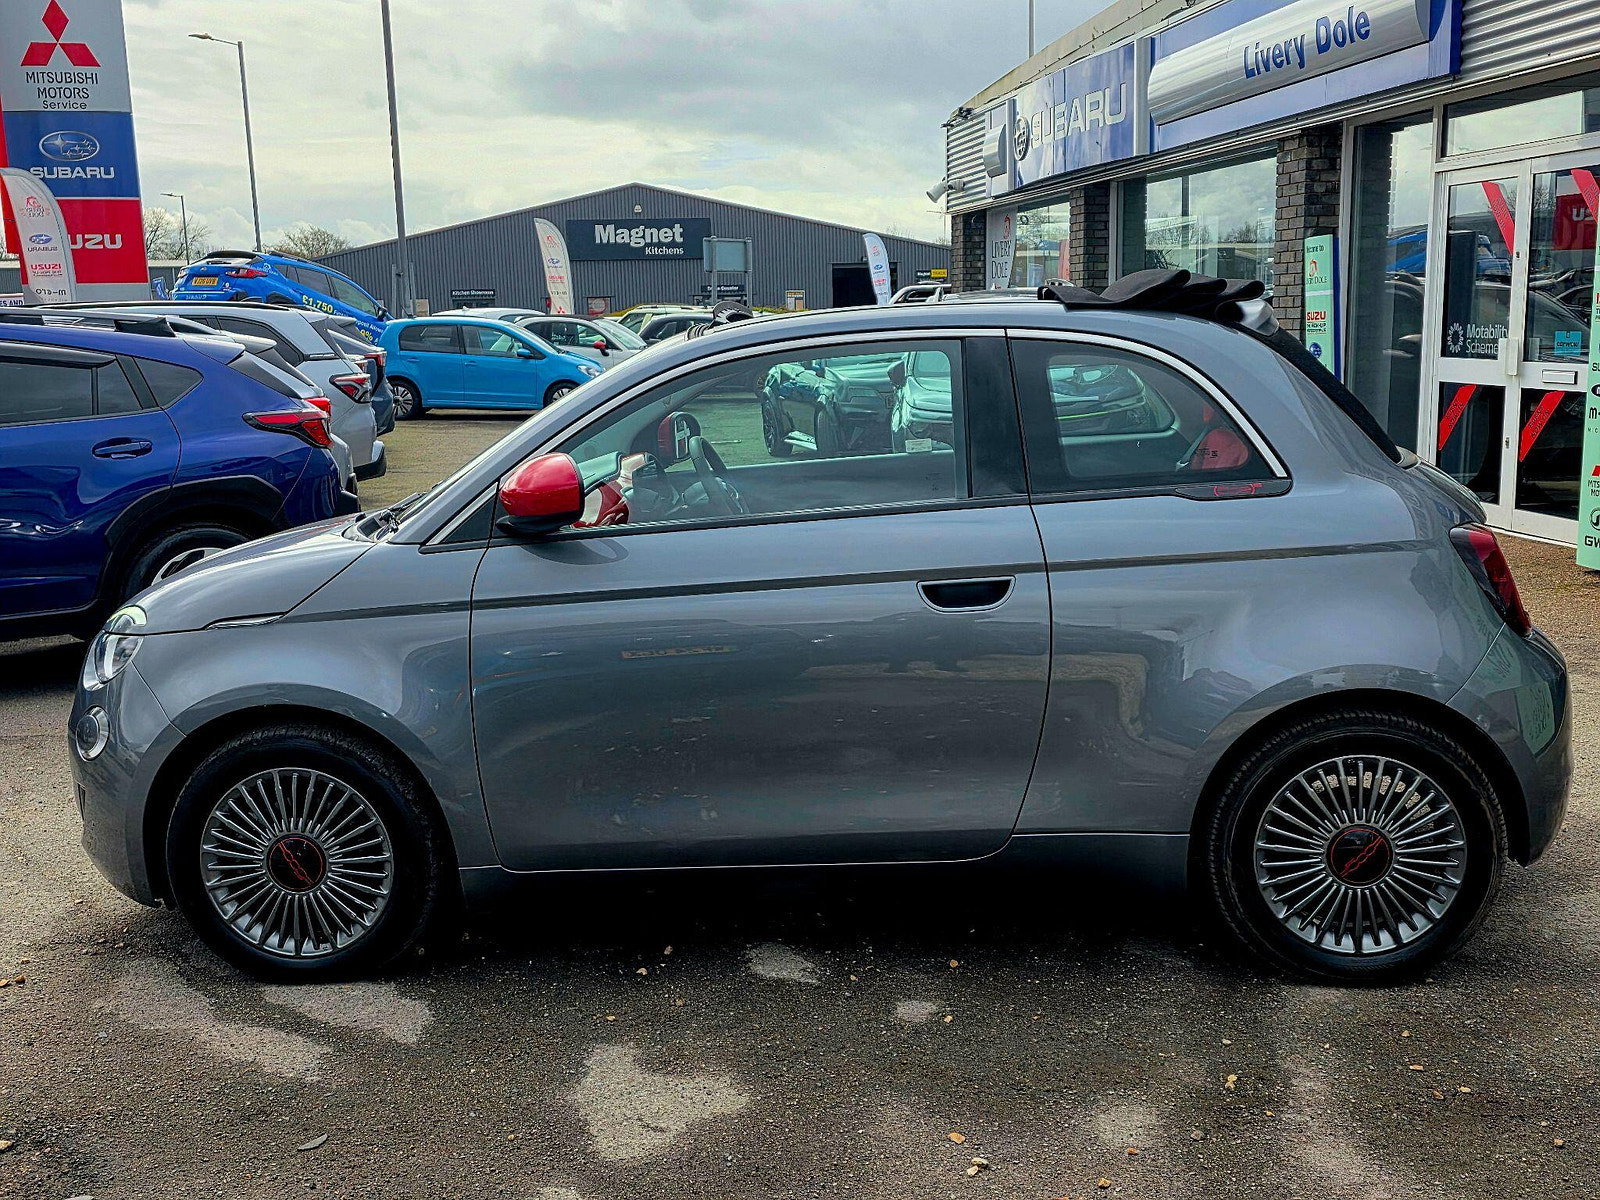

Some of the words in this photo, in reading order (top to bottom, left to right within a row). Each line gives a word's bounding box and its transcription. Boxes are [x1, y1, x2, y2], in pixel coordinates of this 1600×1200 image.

[1243, 34, 1306, 79] Livery
[1316, 5, 1371, 55] Dole
[26, 71, 99, 85] MITSUBISHI
[37, 86, 90, 100] MOTORS
[42, 99, 88, 110] Service
[1031, 82, 1127, 149] SUBARU
[30, 166, 116, 179] SUBARU
[594, 223, 684, 247] Magnet
[645, 245, 684, 255] Kitchens
[991, 240, 1012, 259] LIVERY
[991, 260, 1008, 279] DOLE
[302, 294, 334, 314] £1,750
[1466, 323, 1509, 339] Motability
[1465, 340, 1499, 355] Scheme
